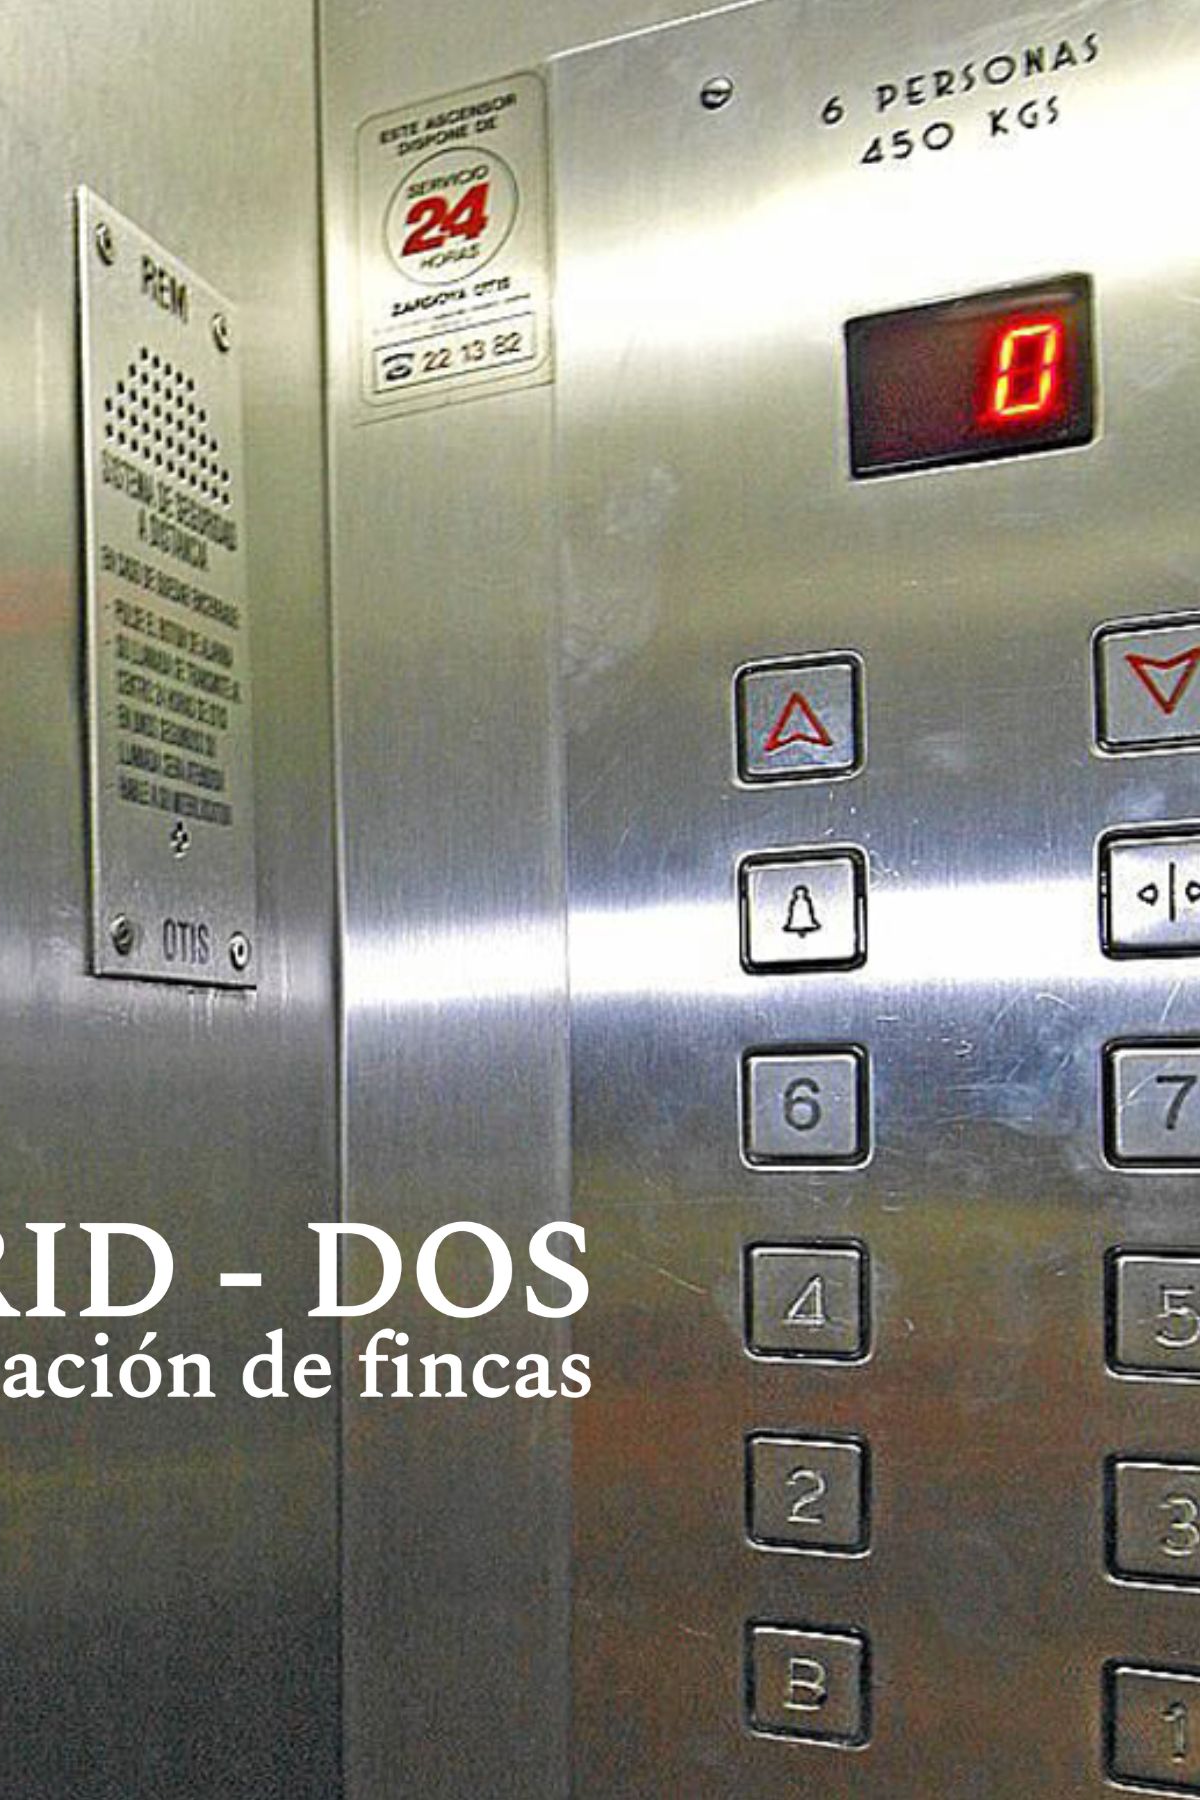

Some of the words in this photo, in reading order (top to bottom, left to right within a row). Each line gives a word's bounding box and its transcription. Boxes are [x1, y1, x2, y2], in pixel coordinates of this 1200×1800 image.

[819, 95, 846, 126] 6
[875, 32, 1100, 114] PERSONAS
[379, 120, 420, 146] ESTE
[424, 92, 518, 130] ASCENSOR
[397, 123, 469, 157] DISPONE
[474, 115, 498, 134] DE
[860, 120, 955, 165] 450
[988, 93, 1062, 138] KGS
[400, 181, 491, 258] 24
[422, 348, 452, 374] 22
[994, 323, 1057, 417] 0
[162, 916, 210, 965] OTIS
[782, 1076, 822, 1132] 6
[1155, 1074, 1198, 1130] 7
[783, 1274, 827, 1326] 4
[1155, 1284, 1200, 1348] 5
[784, 1467, 827, 1525] 2
[1158, 1494, 1200, 1557] 3
[783, 1656, 828, 1712] B
[1160, 1700, 1190, 1764] 1
